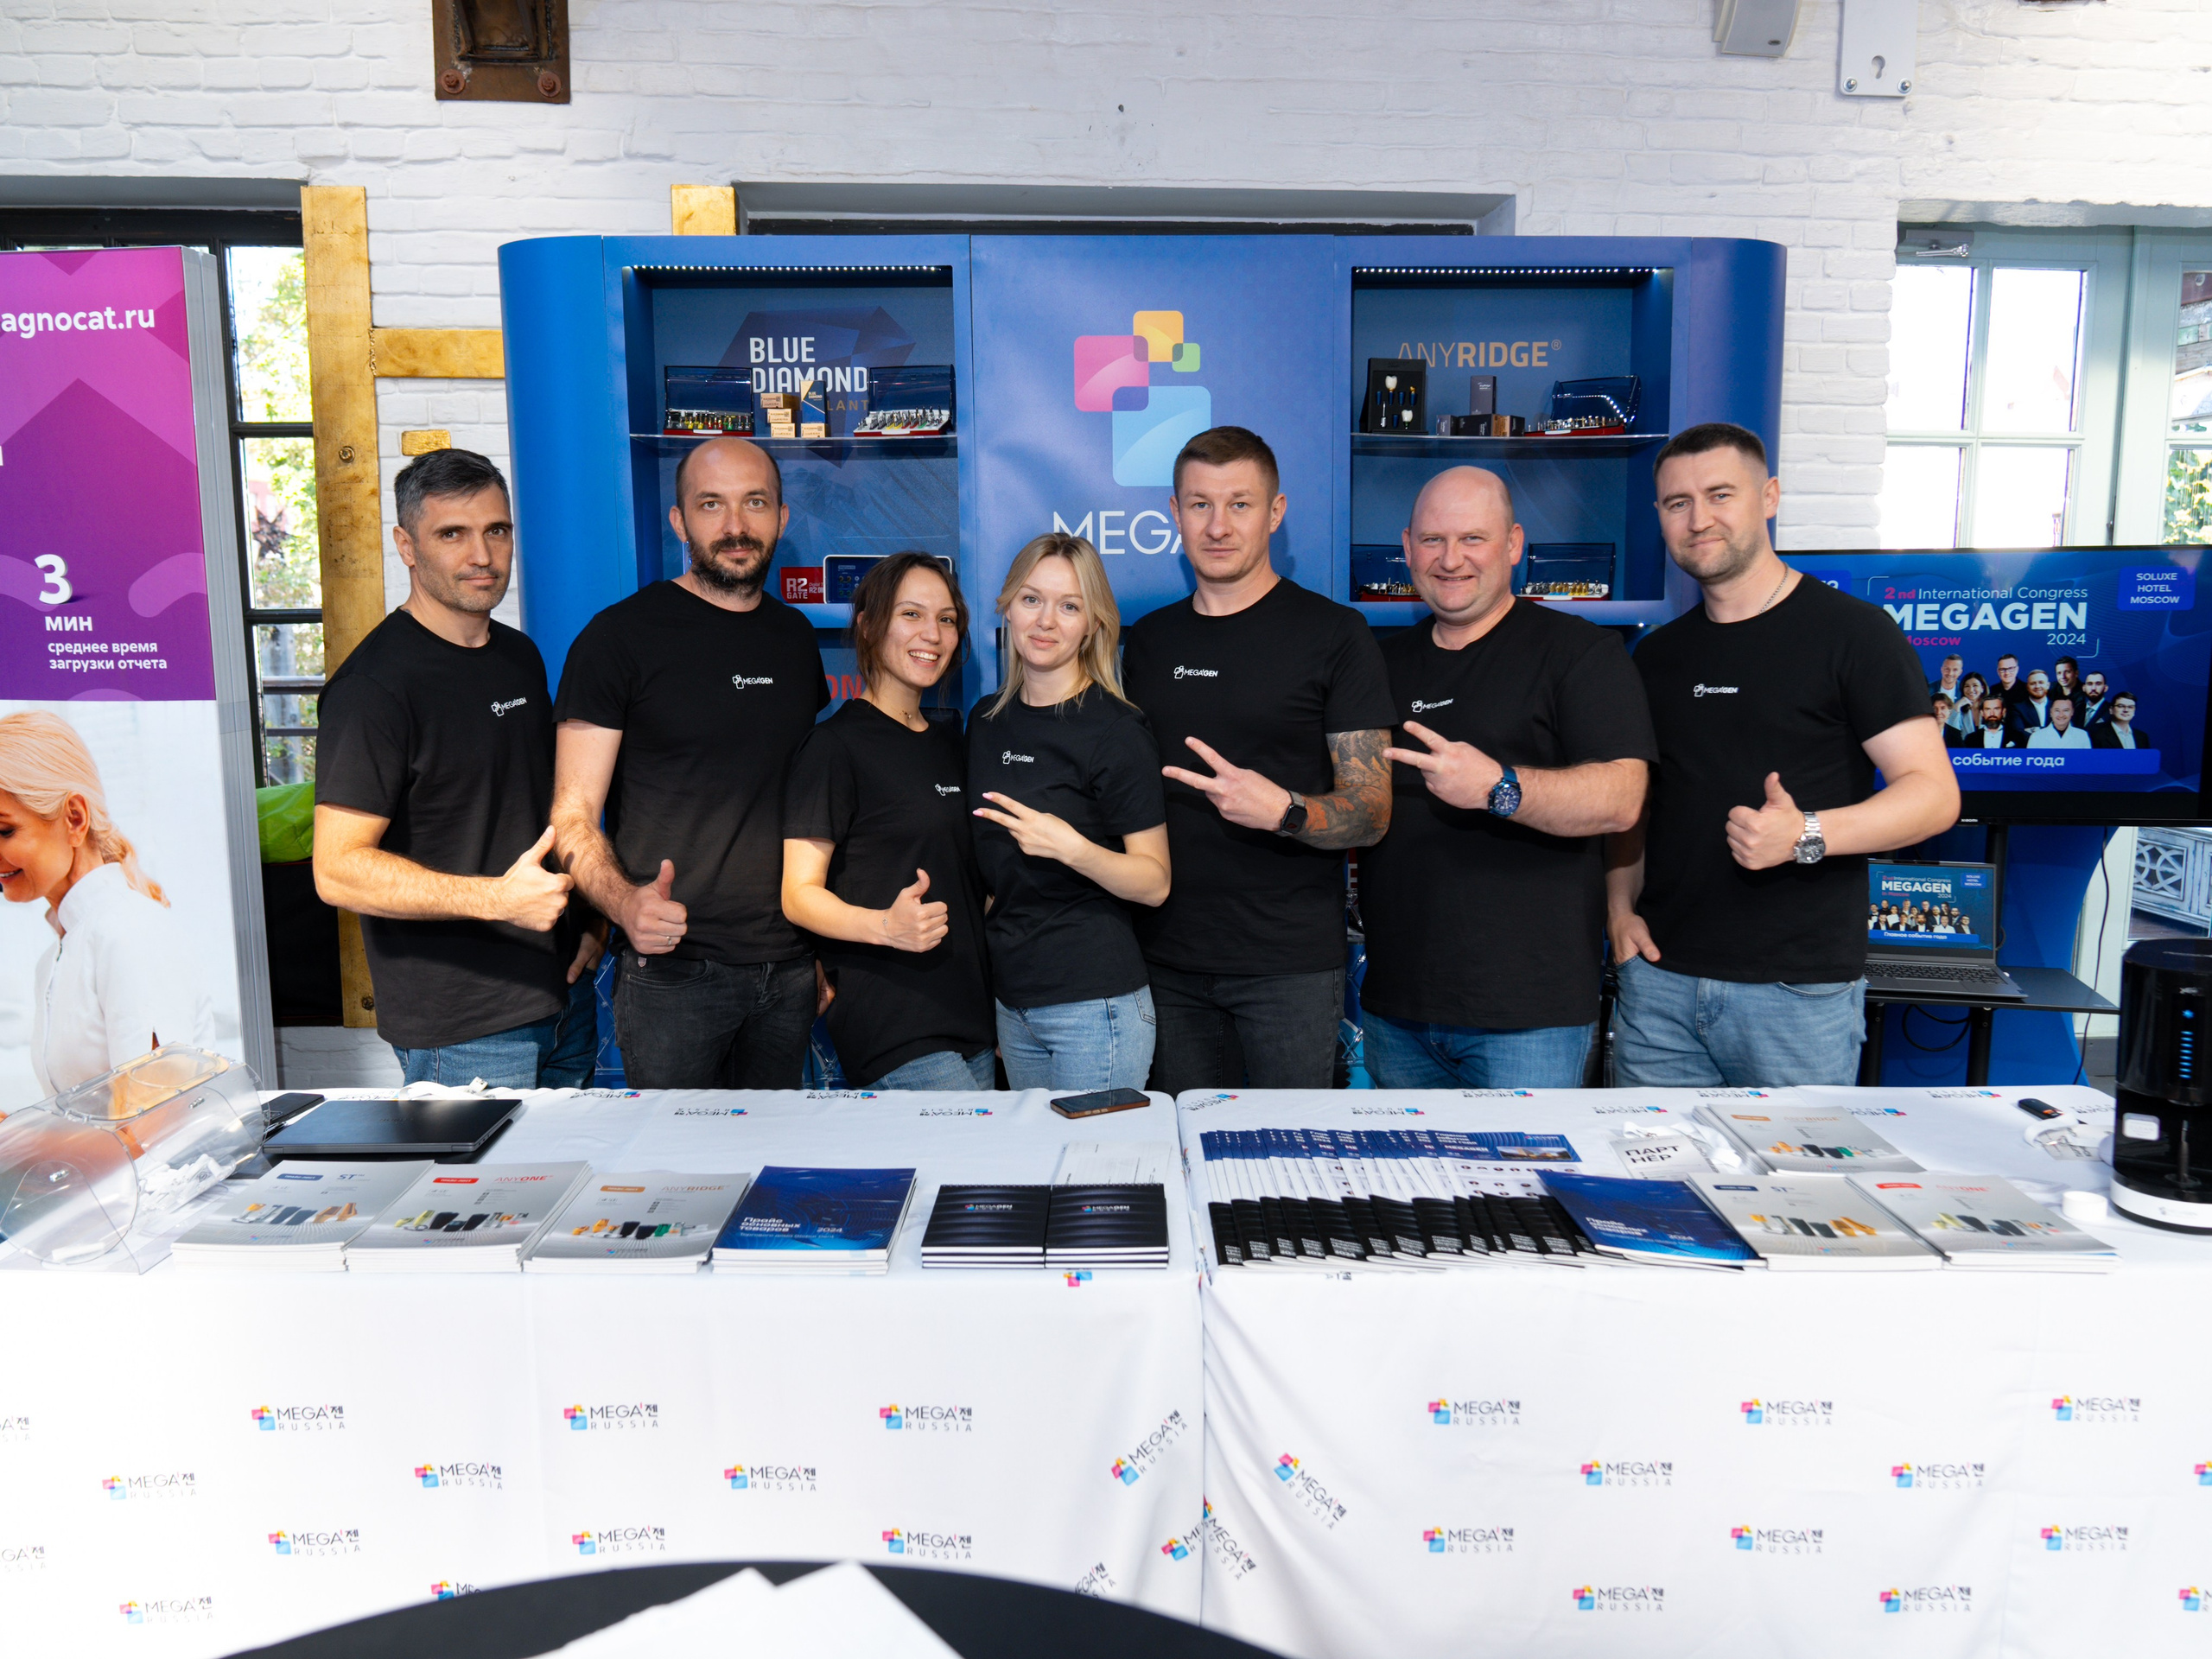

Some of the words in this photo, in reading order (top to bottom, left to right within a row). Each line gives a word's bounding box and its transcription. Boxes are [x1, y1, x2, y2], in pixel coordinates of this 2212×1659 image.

[750, 337, 815, 363] BLUE
[753, 366, 868, 393] DIAMOND
[35, 554, 73, 604] 3
[786, 578, 808, 592] R2
[1884, 587, 1896, 600] 2
[1898, 588, 1916, 600] nd
[1919, 587, 2012, 600] International
[2018, 587, 2088, 601] Congress
[2138, 584, 2172, 593] HOTEL
[1883, 601, 2088, 631] MEGAGEN
[45, 616, 92, 631] мин
[2047, 633, 2086, 645] 2024
[48, 642, 108, 656] среднее
[112, 642, 157, 656] время
[49, 659, 114, 672] загрузки
[118, 658, 167, 670] отчета
[1953, 753, 2022, 766] событие
[2026, 756, 2065, 767] года
[1882, 881, 1951, 893] MEGAGEN
[1624, 1146, 1680, 1155] ПАРТ
